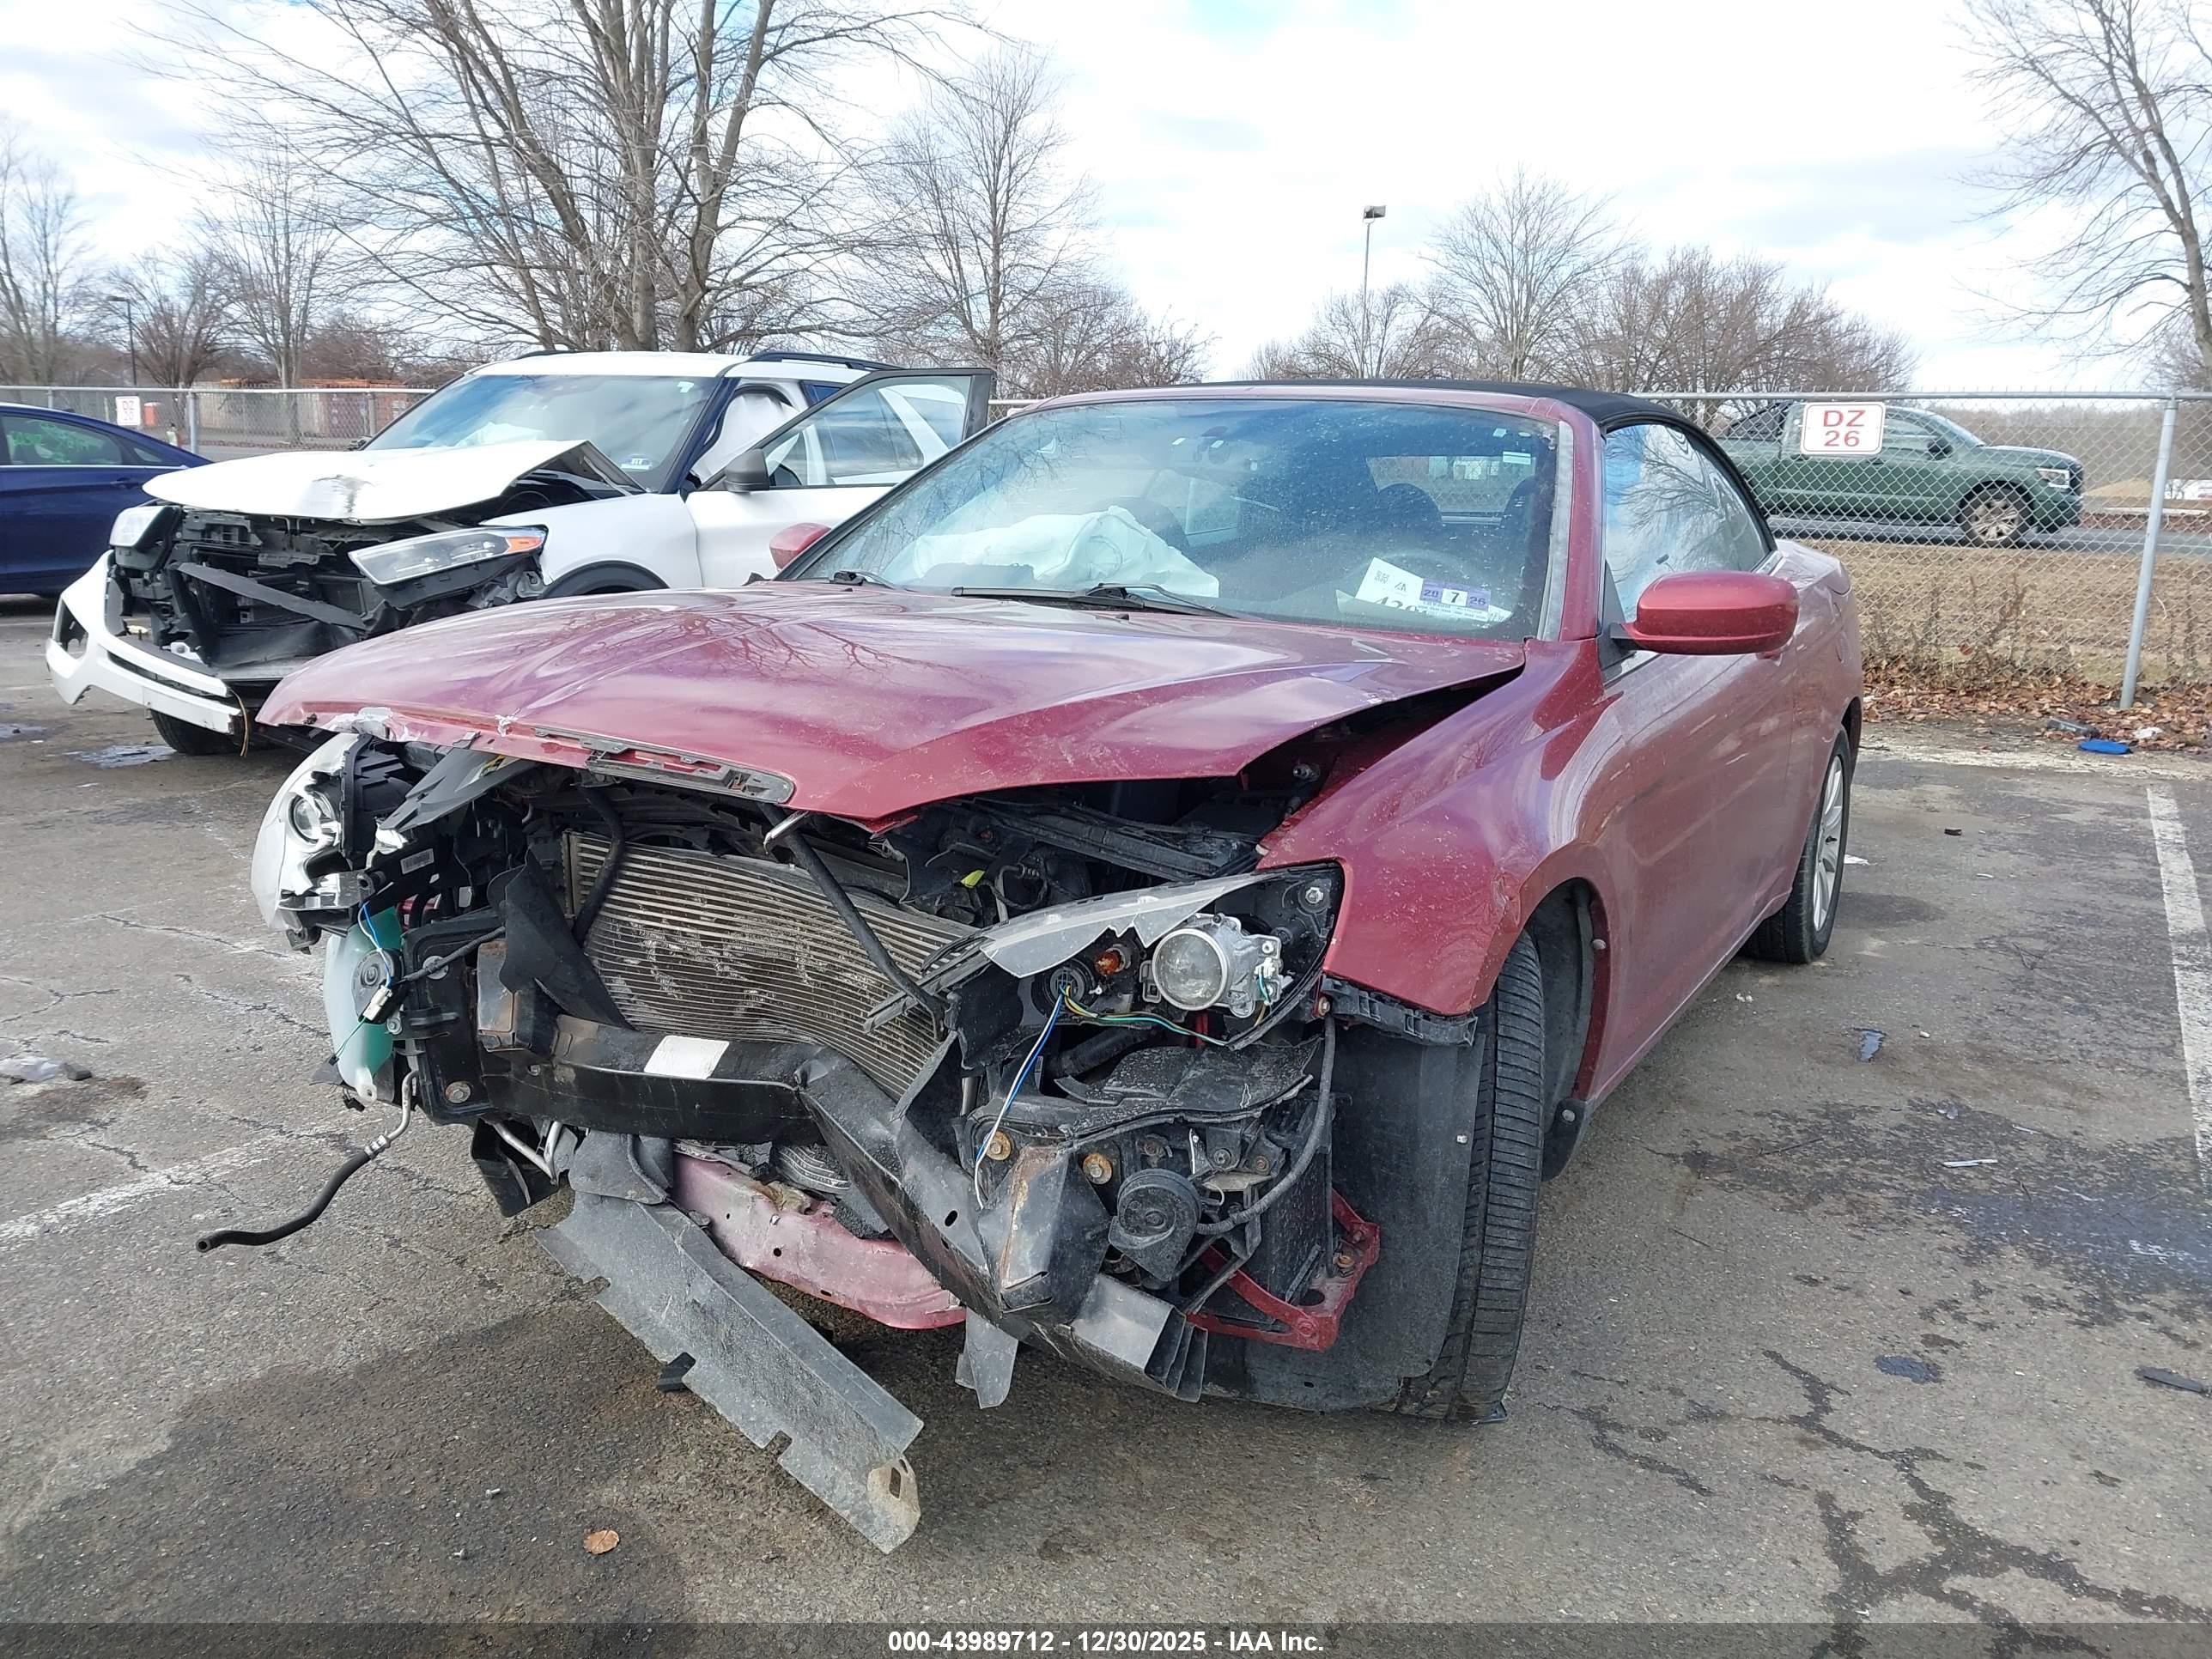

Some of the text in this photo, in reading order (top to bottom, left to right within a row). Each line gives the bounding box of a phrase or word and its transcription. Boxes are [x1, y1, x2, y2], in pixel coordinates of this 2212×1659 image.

[1823, 410, 1866, 427] DZ
[1824, 430, 1860, 447] 26
[1423, 589, 1486, 606] 20 7 26
